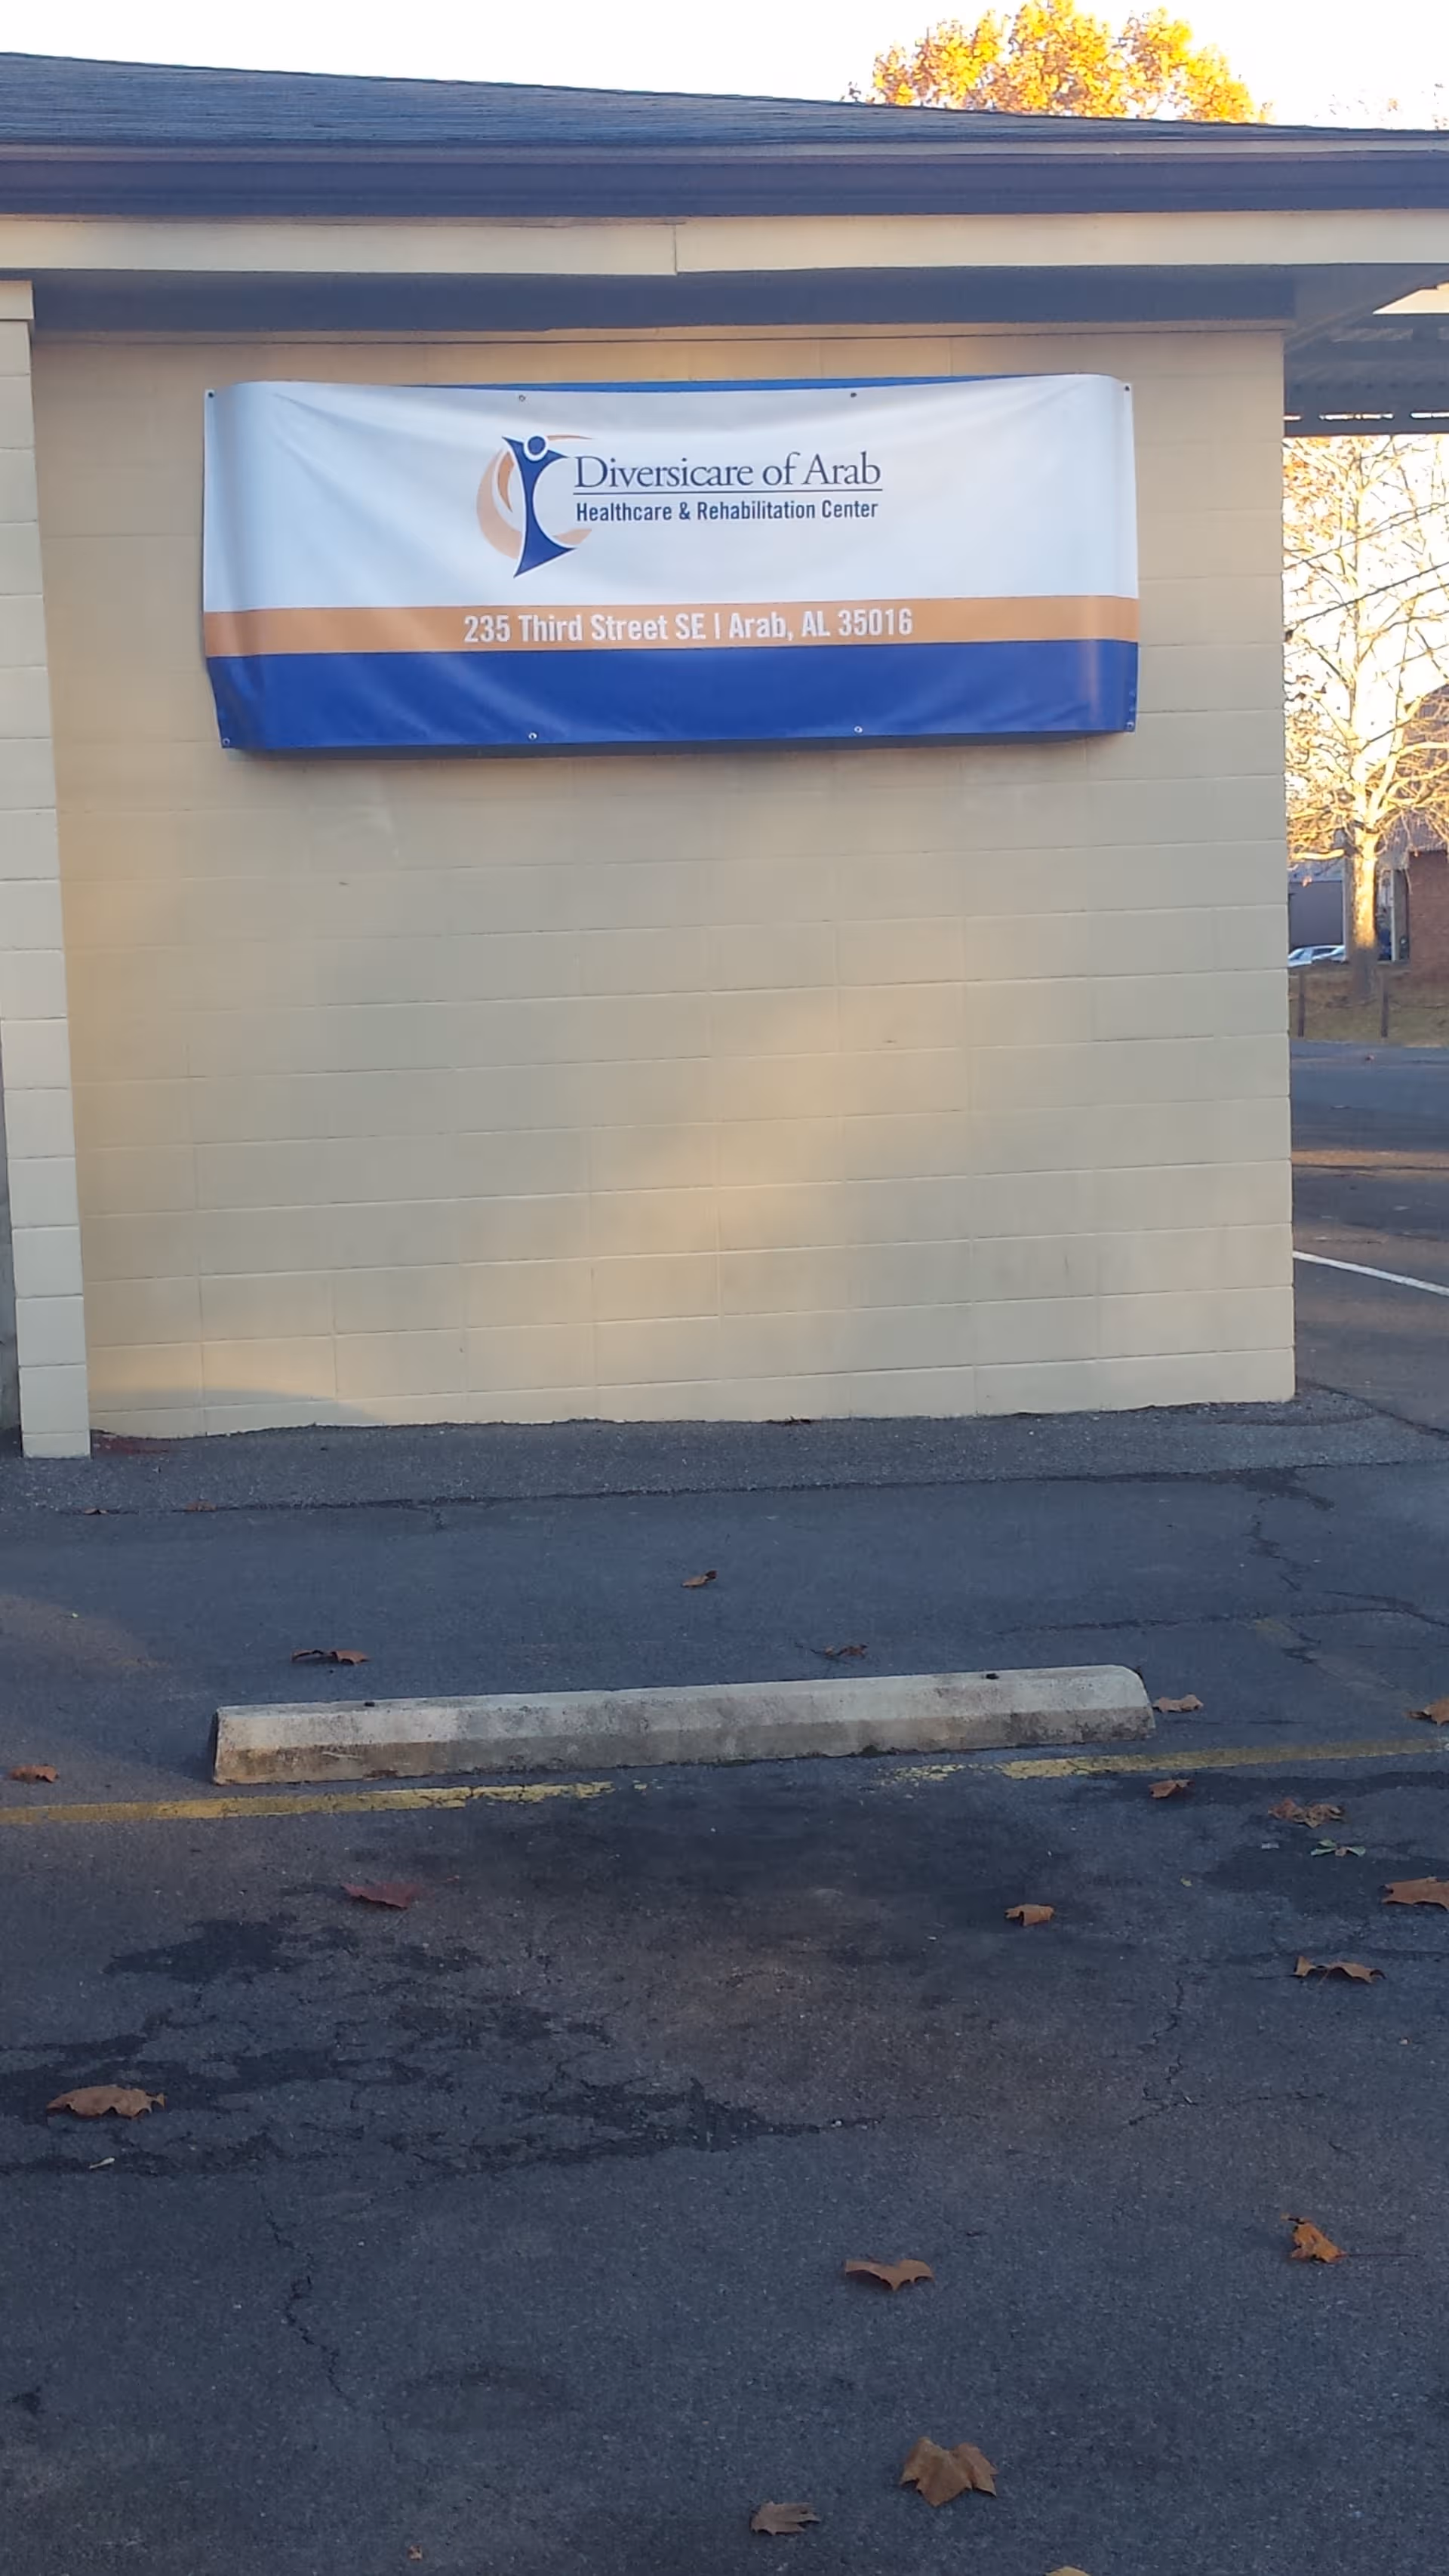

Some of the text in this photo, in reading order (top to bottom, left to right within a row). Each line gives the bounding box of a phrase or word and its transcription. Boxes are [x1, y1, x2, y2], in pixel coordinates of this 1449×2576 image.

[574, 451, 881, 488] Diversicare of Arab
[577, 499, 878, 521] Healthcare & Rehabilitation Center
[464, 614, 510, 642] 235
[518, 613, 583, 642] Third
[591, 612, 669, 641] Street
[675, 612, 706, 640] SE
[729, 611, 792, 641] Arab,
[801, 611, 830, 637] AL
[838, 608, 912, 636] 35016
